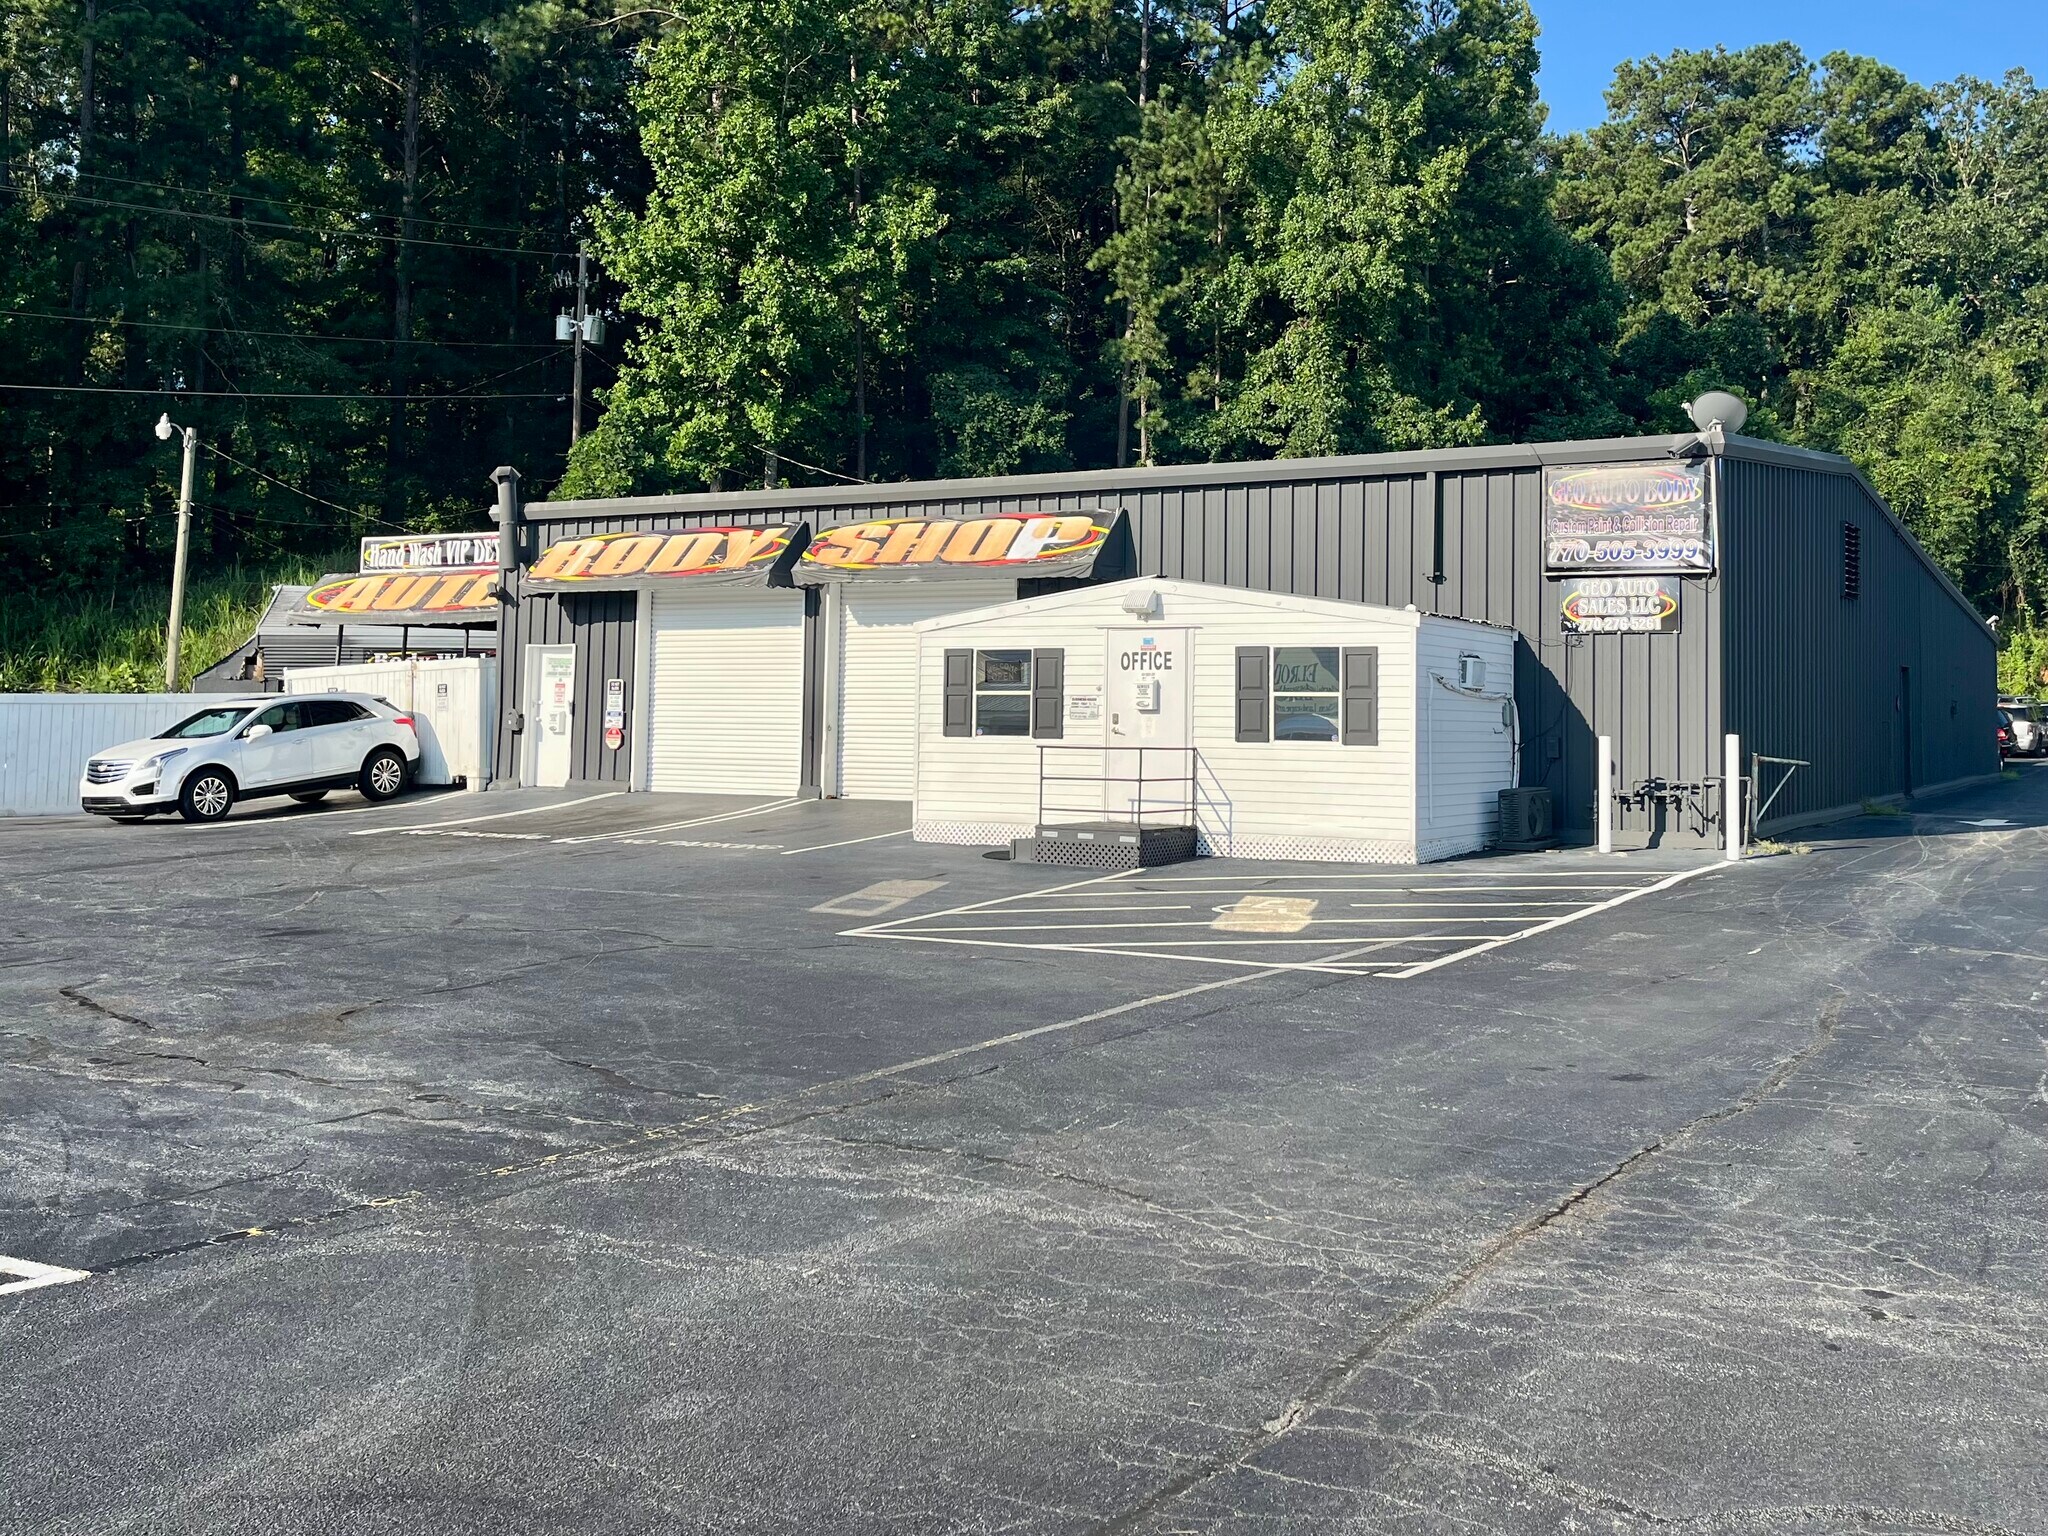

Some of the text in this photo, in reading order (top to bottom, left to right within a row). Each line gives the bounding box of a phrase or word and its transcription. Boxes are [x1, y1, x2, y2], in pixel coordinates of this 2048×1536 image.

[1551, 477, 1699, 505] GEO AUTO BODY
[1551, 514, 1698, 535] Custom Paint & Collision Repair
[814, 516, 1094, 564] SHOP
[1549, 538, 1700, 563] 770-505-3999
[369, 543, 406, 567] Hand
[408, 541, 443, 566] Wash
[445, 540, 470, 565] VIP
[533, 527, 790, 579] BODY
[1578, 578, 1659, 596] GEO AUTO
[1578, 597, 1662, 616] SALES LLC
[1578, 617, 1662, 632] 770-276-5261
[1120, 651, 1173, 670] OFFICE
[991, 671, 1015, 681] OPEN
